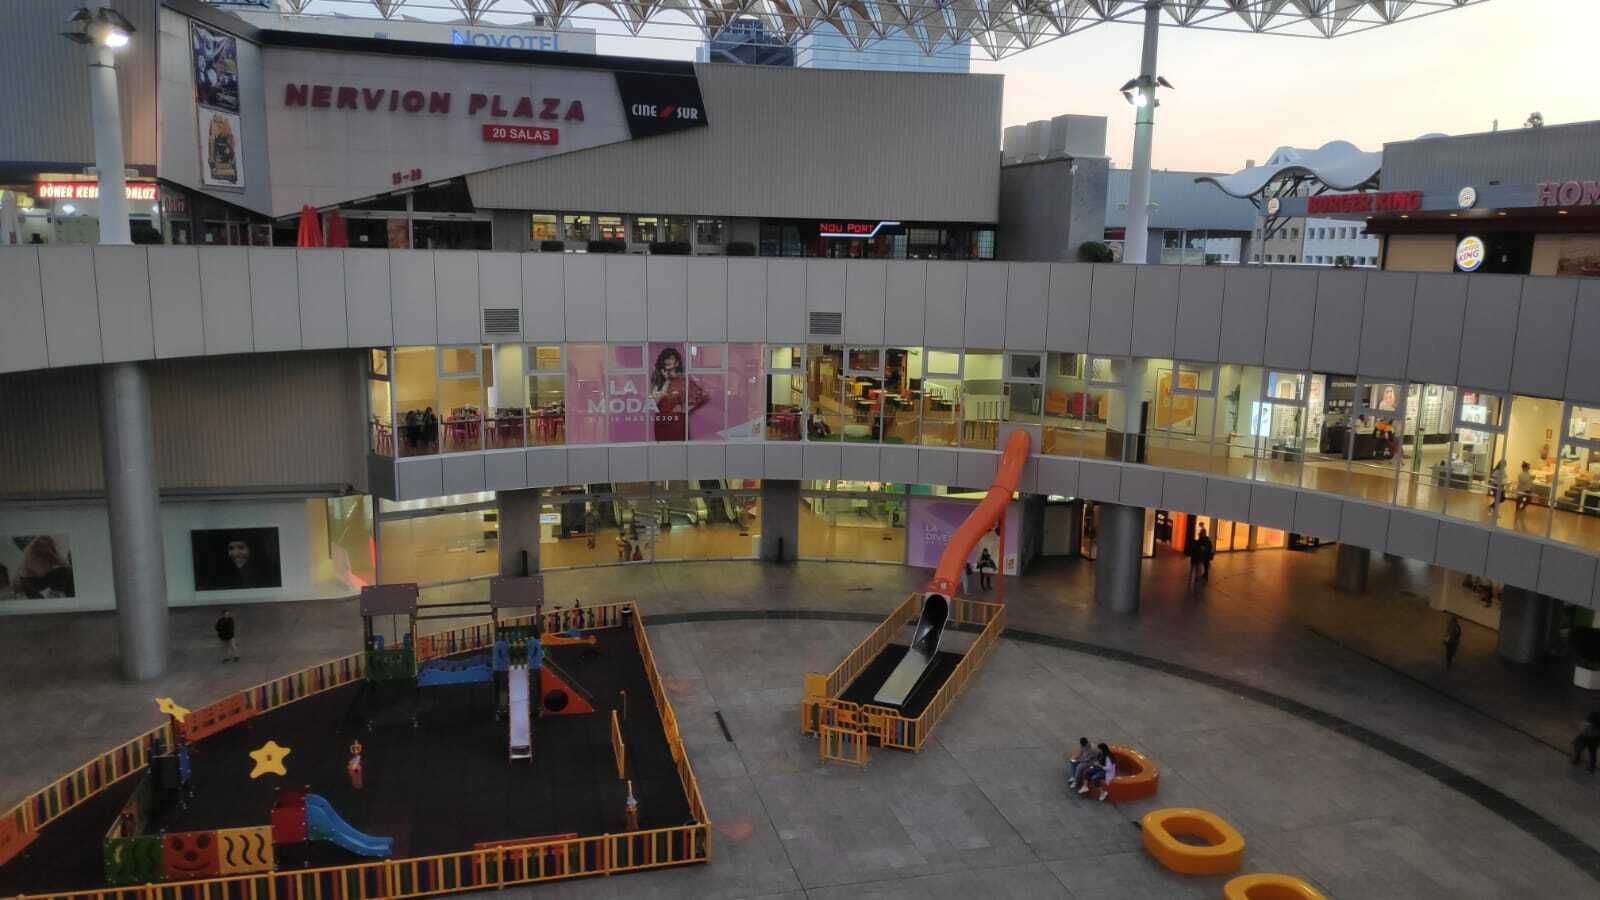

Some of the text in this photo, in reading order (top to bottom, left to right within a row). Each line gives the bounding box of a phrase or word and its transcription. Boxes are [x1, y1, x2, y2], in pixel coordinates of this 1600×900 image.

[285, 83, 585, 121] NERVION PLAZA
[676, 107, 698, 120] SUR
[492, 127, 551, 141] 20 SALAS
[1307, 190, 1423, 214] BURGER KING
[1459, 249, 1480, 261] KING
[609, 380, 637, 395] LA
[587, 398, 660, 414] MODA
